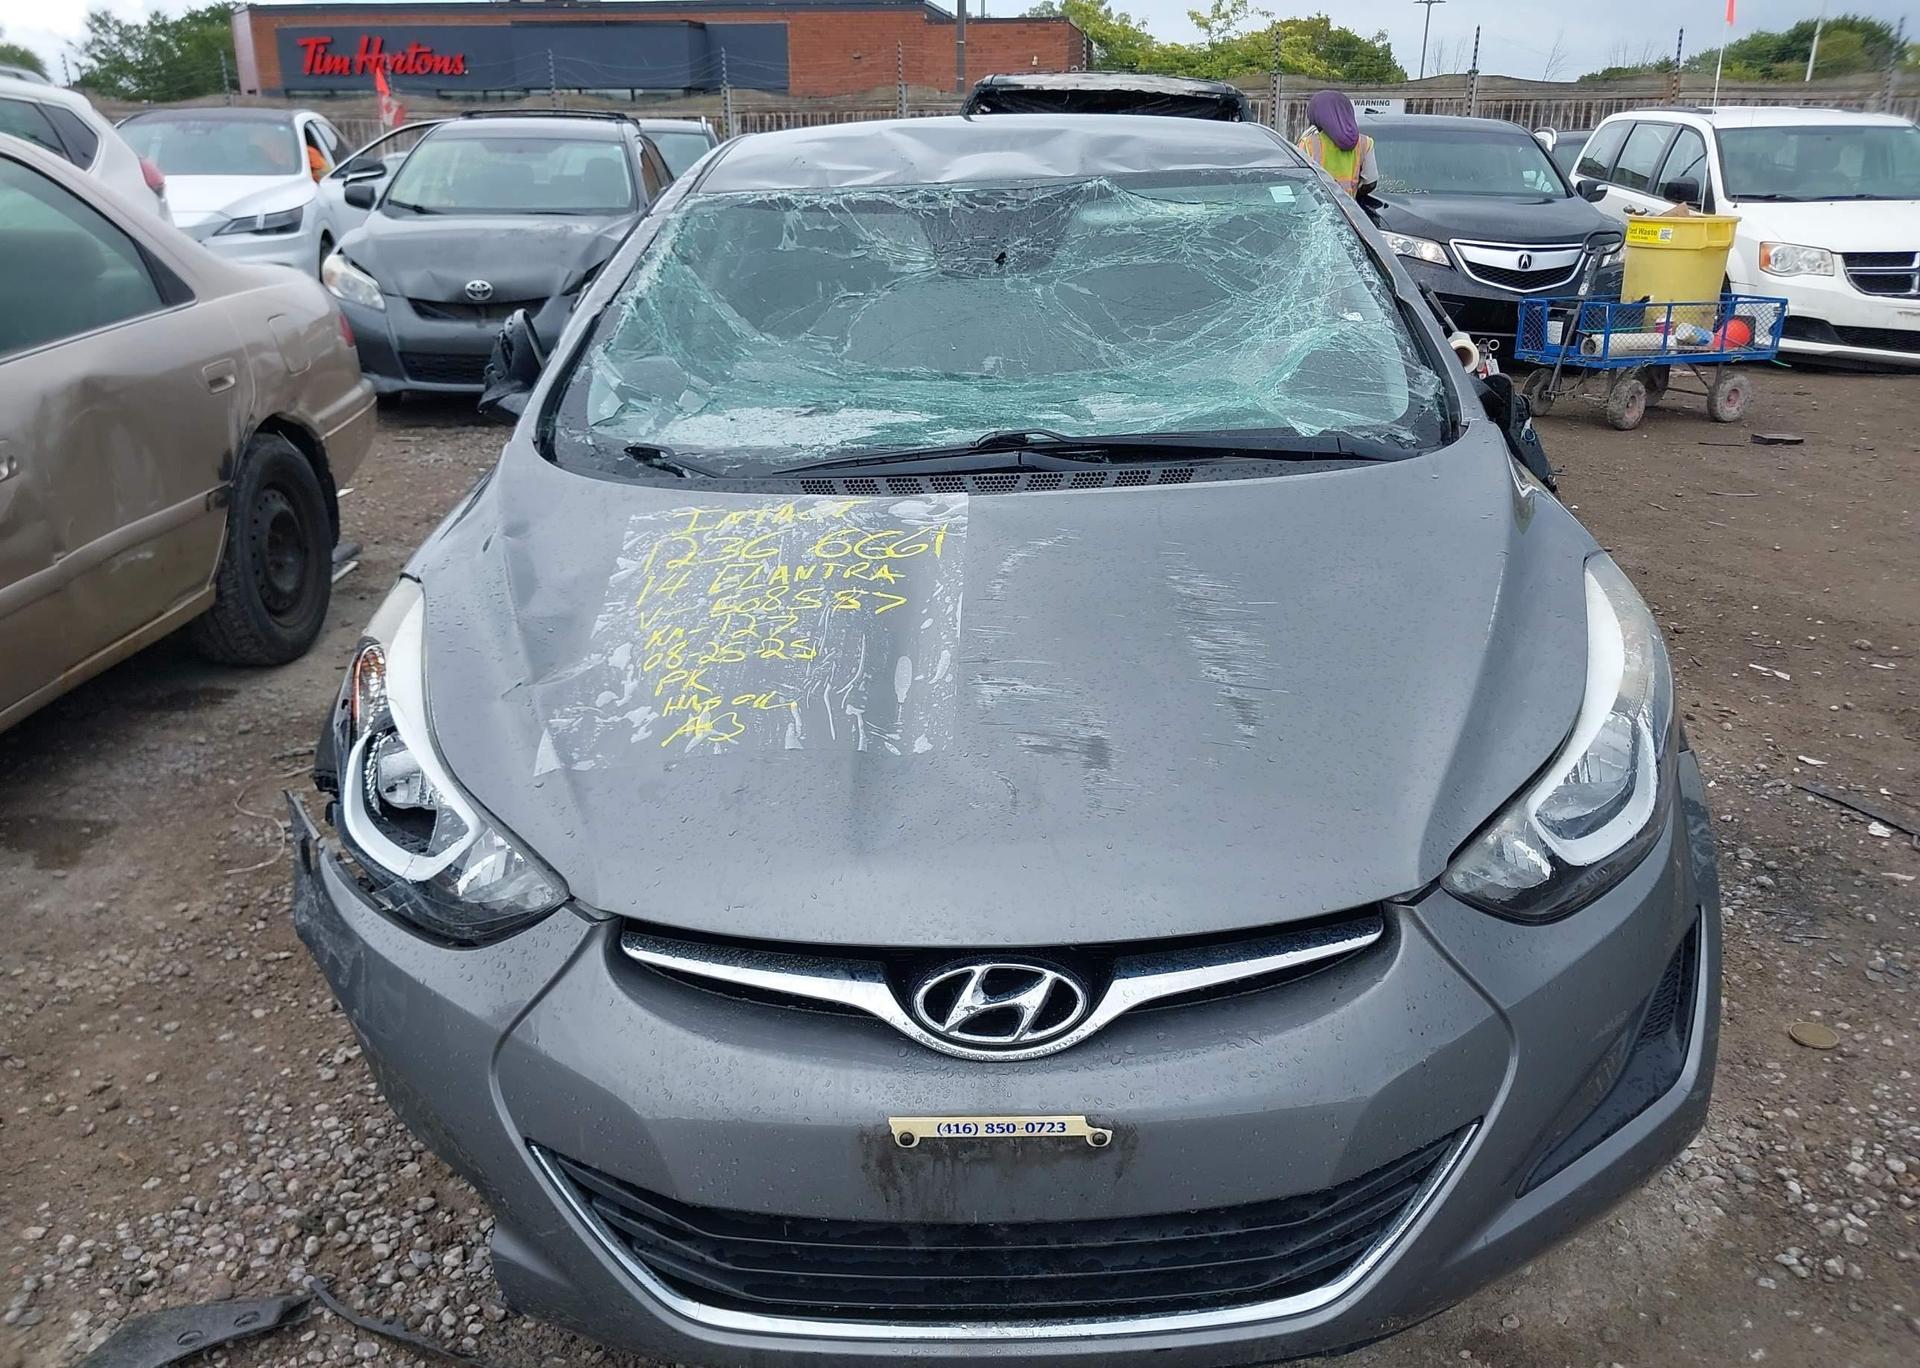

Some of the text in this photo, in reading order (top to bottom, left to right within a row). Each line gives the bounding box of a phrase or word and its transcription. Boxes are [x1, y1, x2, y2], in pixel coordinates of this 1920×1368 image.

[296, 36, 351, 76] Tim
[1353, 99, 1391, 107] WARNING
[1638, 227, 1658, 236] Waste
[708, 561, 906, 595] ELANTRA
[655, 667, 713, 697] PK
[937, 1121, 1067, 1136] (416) 850-0723
